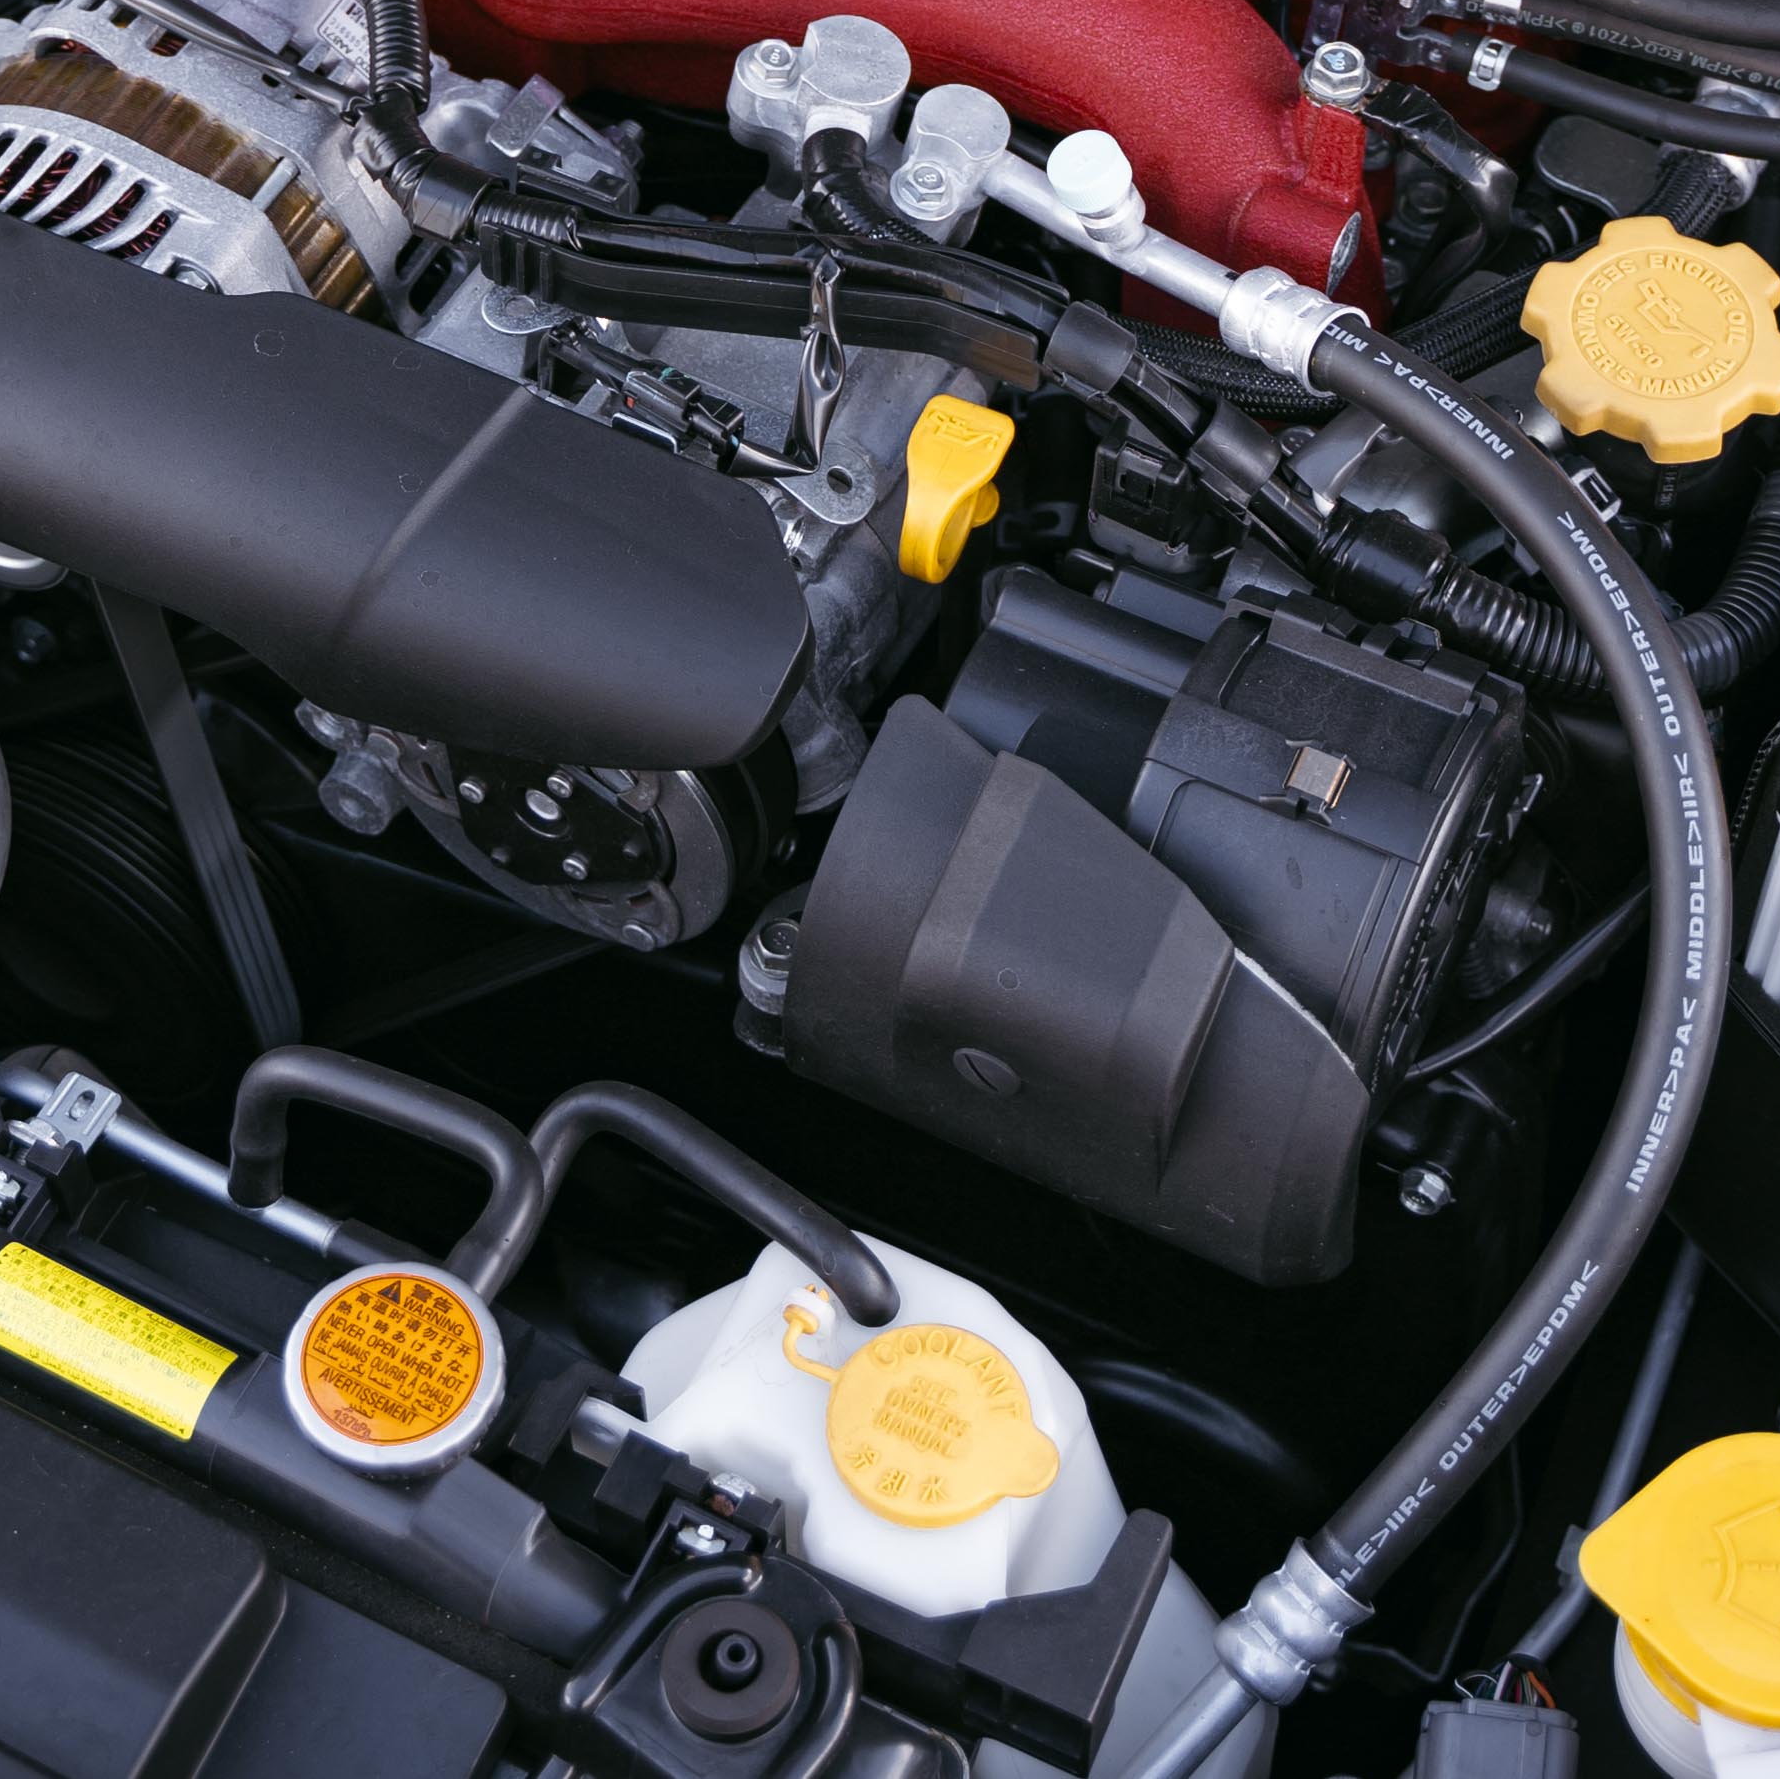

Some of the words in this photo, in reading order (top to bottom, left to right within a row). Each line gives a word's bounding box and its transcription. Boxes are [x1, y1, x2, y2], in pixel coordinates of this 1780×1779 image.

[1592, 258, 1638, 291] SEE
[1649, 253, 1736, 306] ENGINE
[1726, 306, 1750, 348] OIL
[1575, 292, 1636, 385] OWNER'S
[1604, 313, 1664, 369] 5W-30
[1638, 355, 1735, 396] MANUAL
[402, 1296, 465, 1337] WARNING
[409, 1282, 455, 1315] 警告
[316, 1326, 332, 1343] NE
[331, 1334, 371, 1363] JAMAIS
[369, 1354, 409, 1383] OUVRIR
[325, 1312, 366, 1341] NEVER
[365, 1331, 400, 1359] OPEN
[399, 1351, 436, 1379] WHEN
[319, 1364, 419, 1427] AVERTISSEMENT
[872, 1329, 1022, 1419] COOLANT
[909, 1377, 956, 1407] SEE
[874, 1408, 957, 1457] MANUAL
